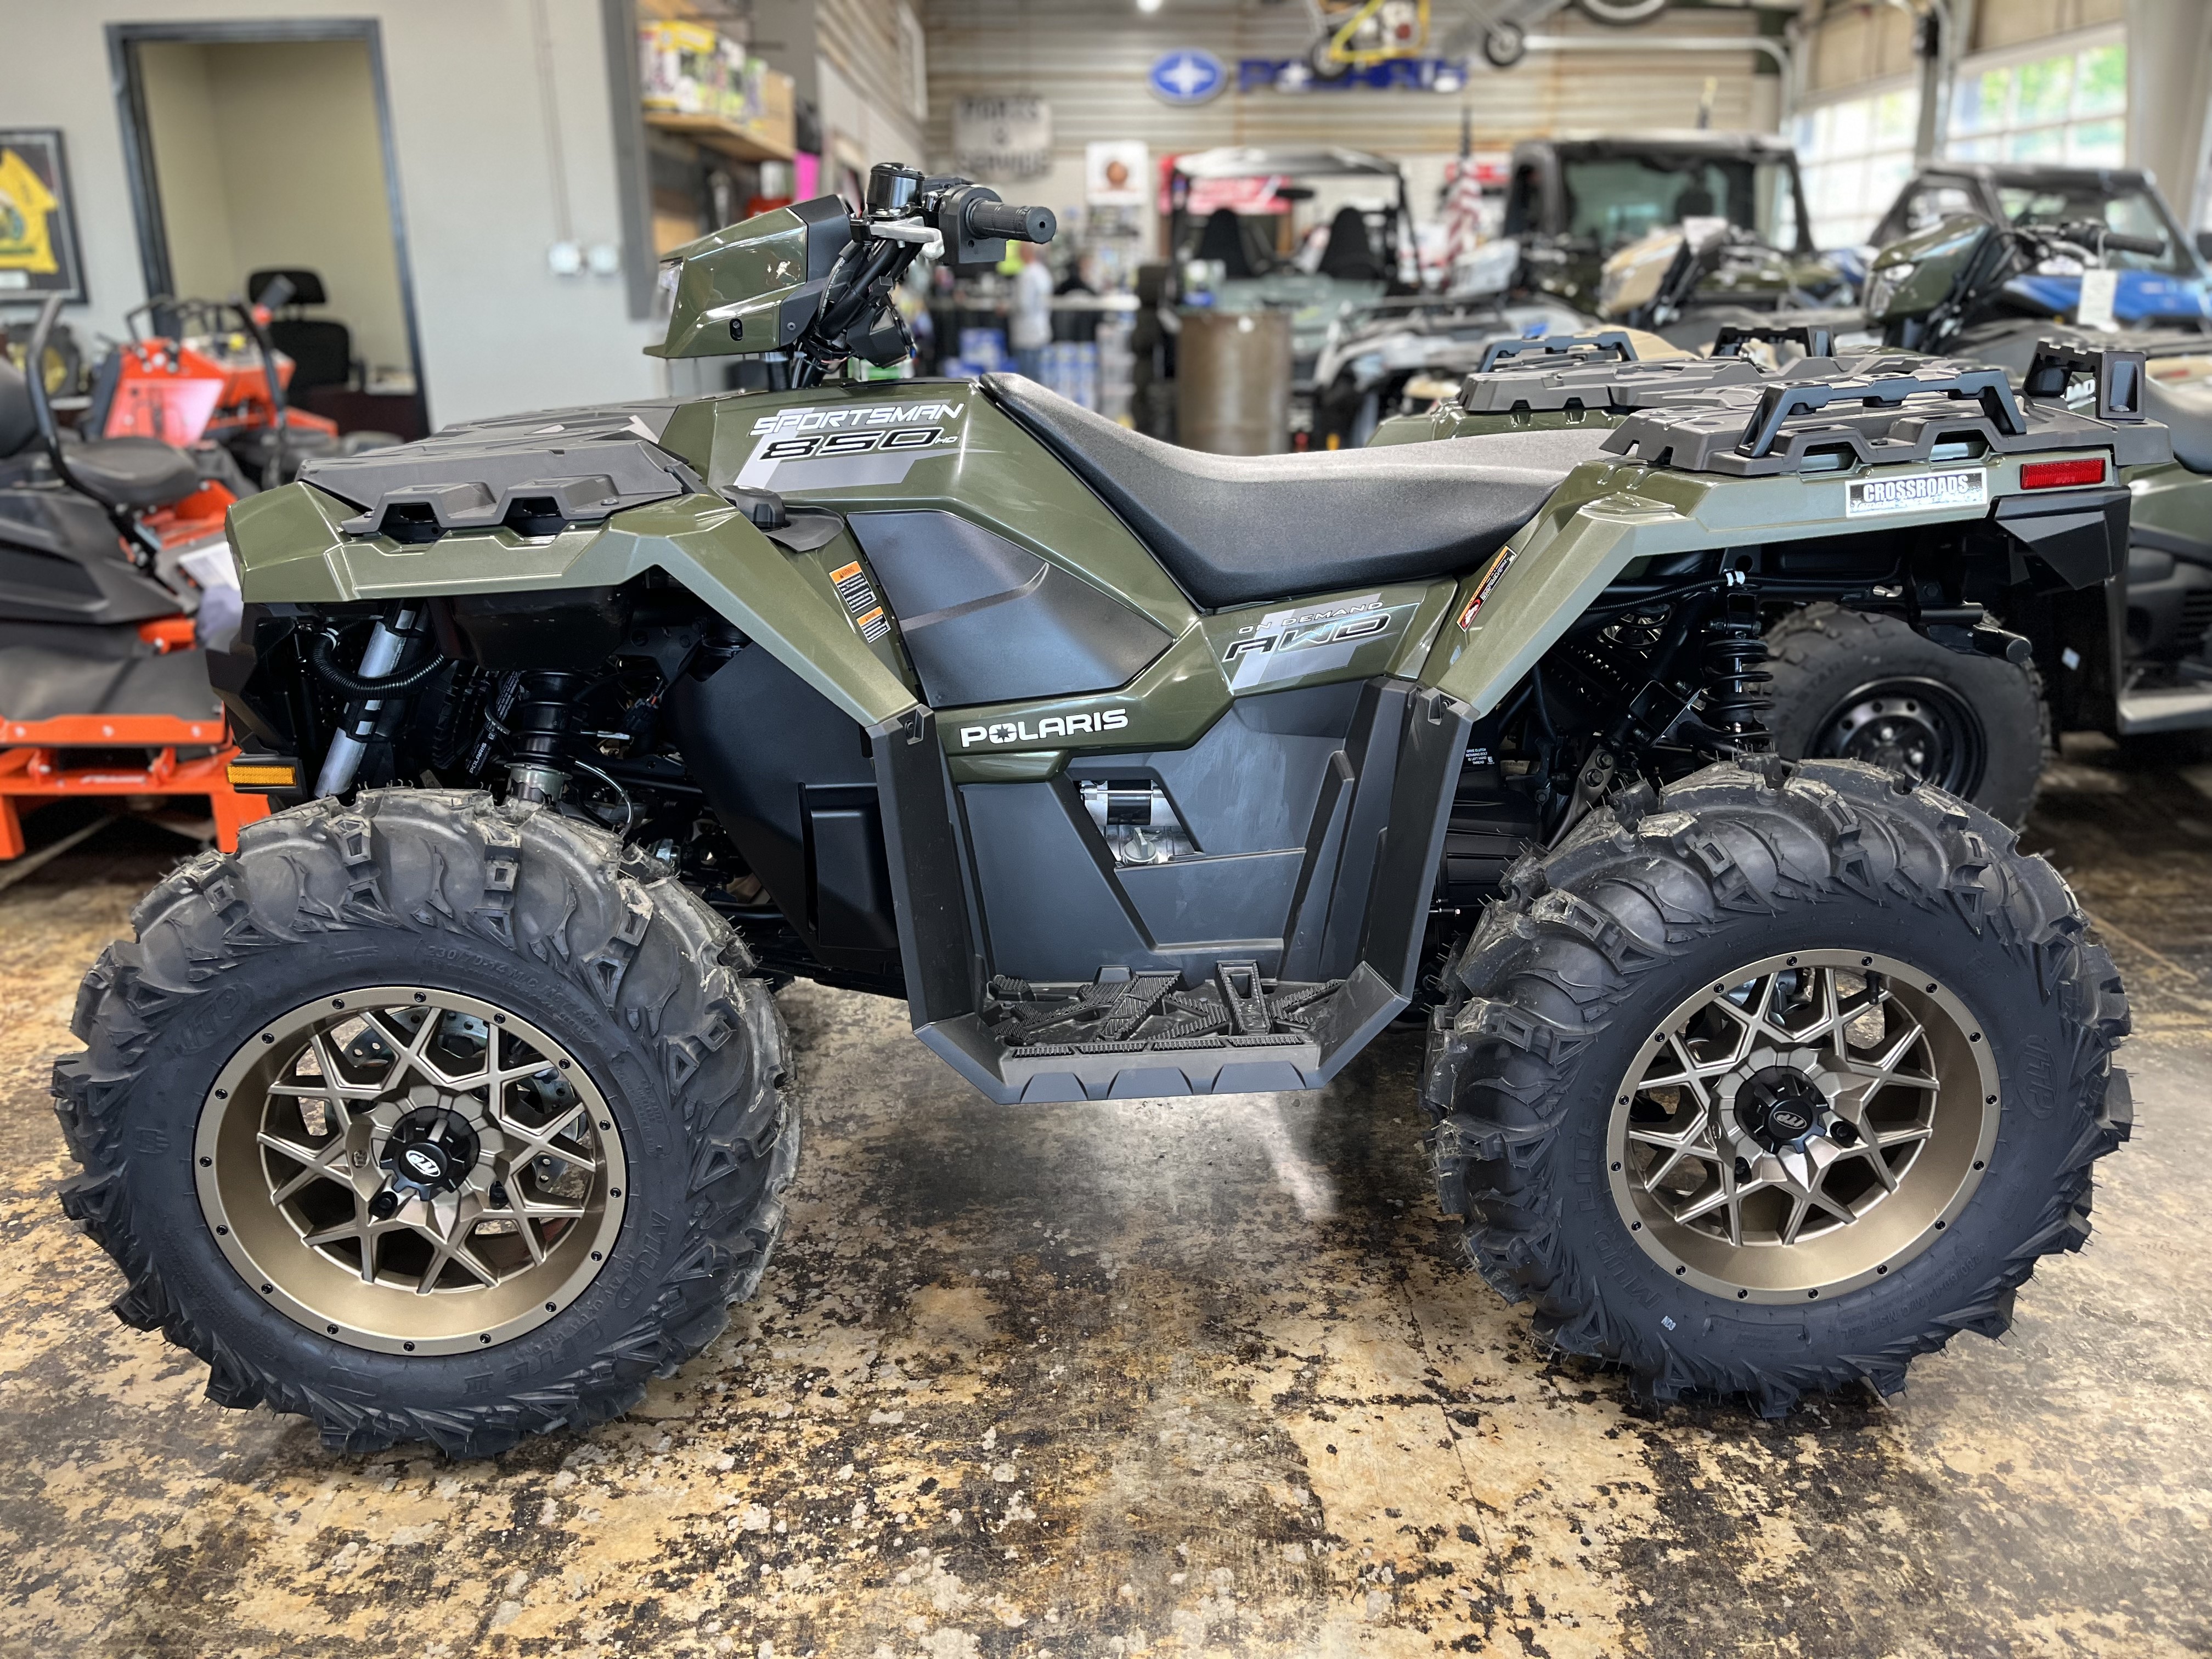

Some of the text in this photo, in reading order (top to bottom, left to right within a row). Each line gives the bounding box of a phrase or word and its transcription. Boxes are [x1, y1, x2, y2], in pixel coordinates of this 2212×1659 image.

[747, 403, 966, 436] SPORTSMAN
[757, 427, 958, 461] 850 HD
[1863, 475, 1969, 503] CROSSROADS
[1238, 601, 1384, 635] ON DEMAND
[1222, 613, 1392, 663] AWD
[960, 708, 1129, 748] POLARIS
[469, 742, 487, 774] POLARIS
[1776, 1114, 1804, 1127] ITP
[409, 1154, 438, 1174] ITP
[614, 1209, 671, 1310] MUD
[1594, 1230, 1664, 1310] MUD
[1661, 1315, 1677, 1331] ND3
